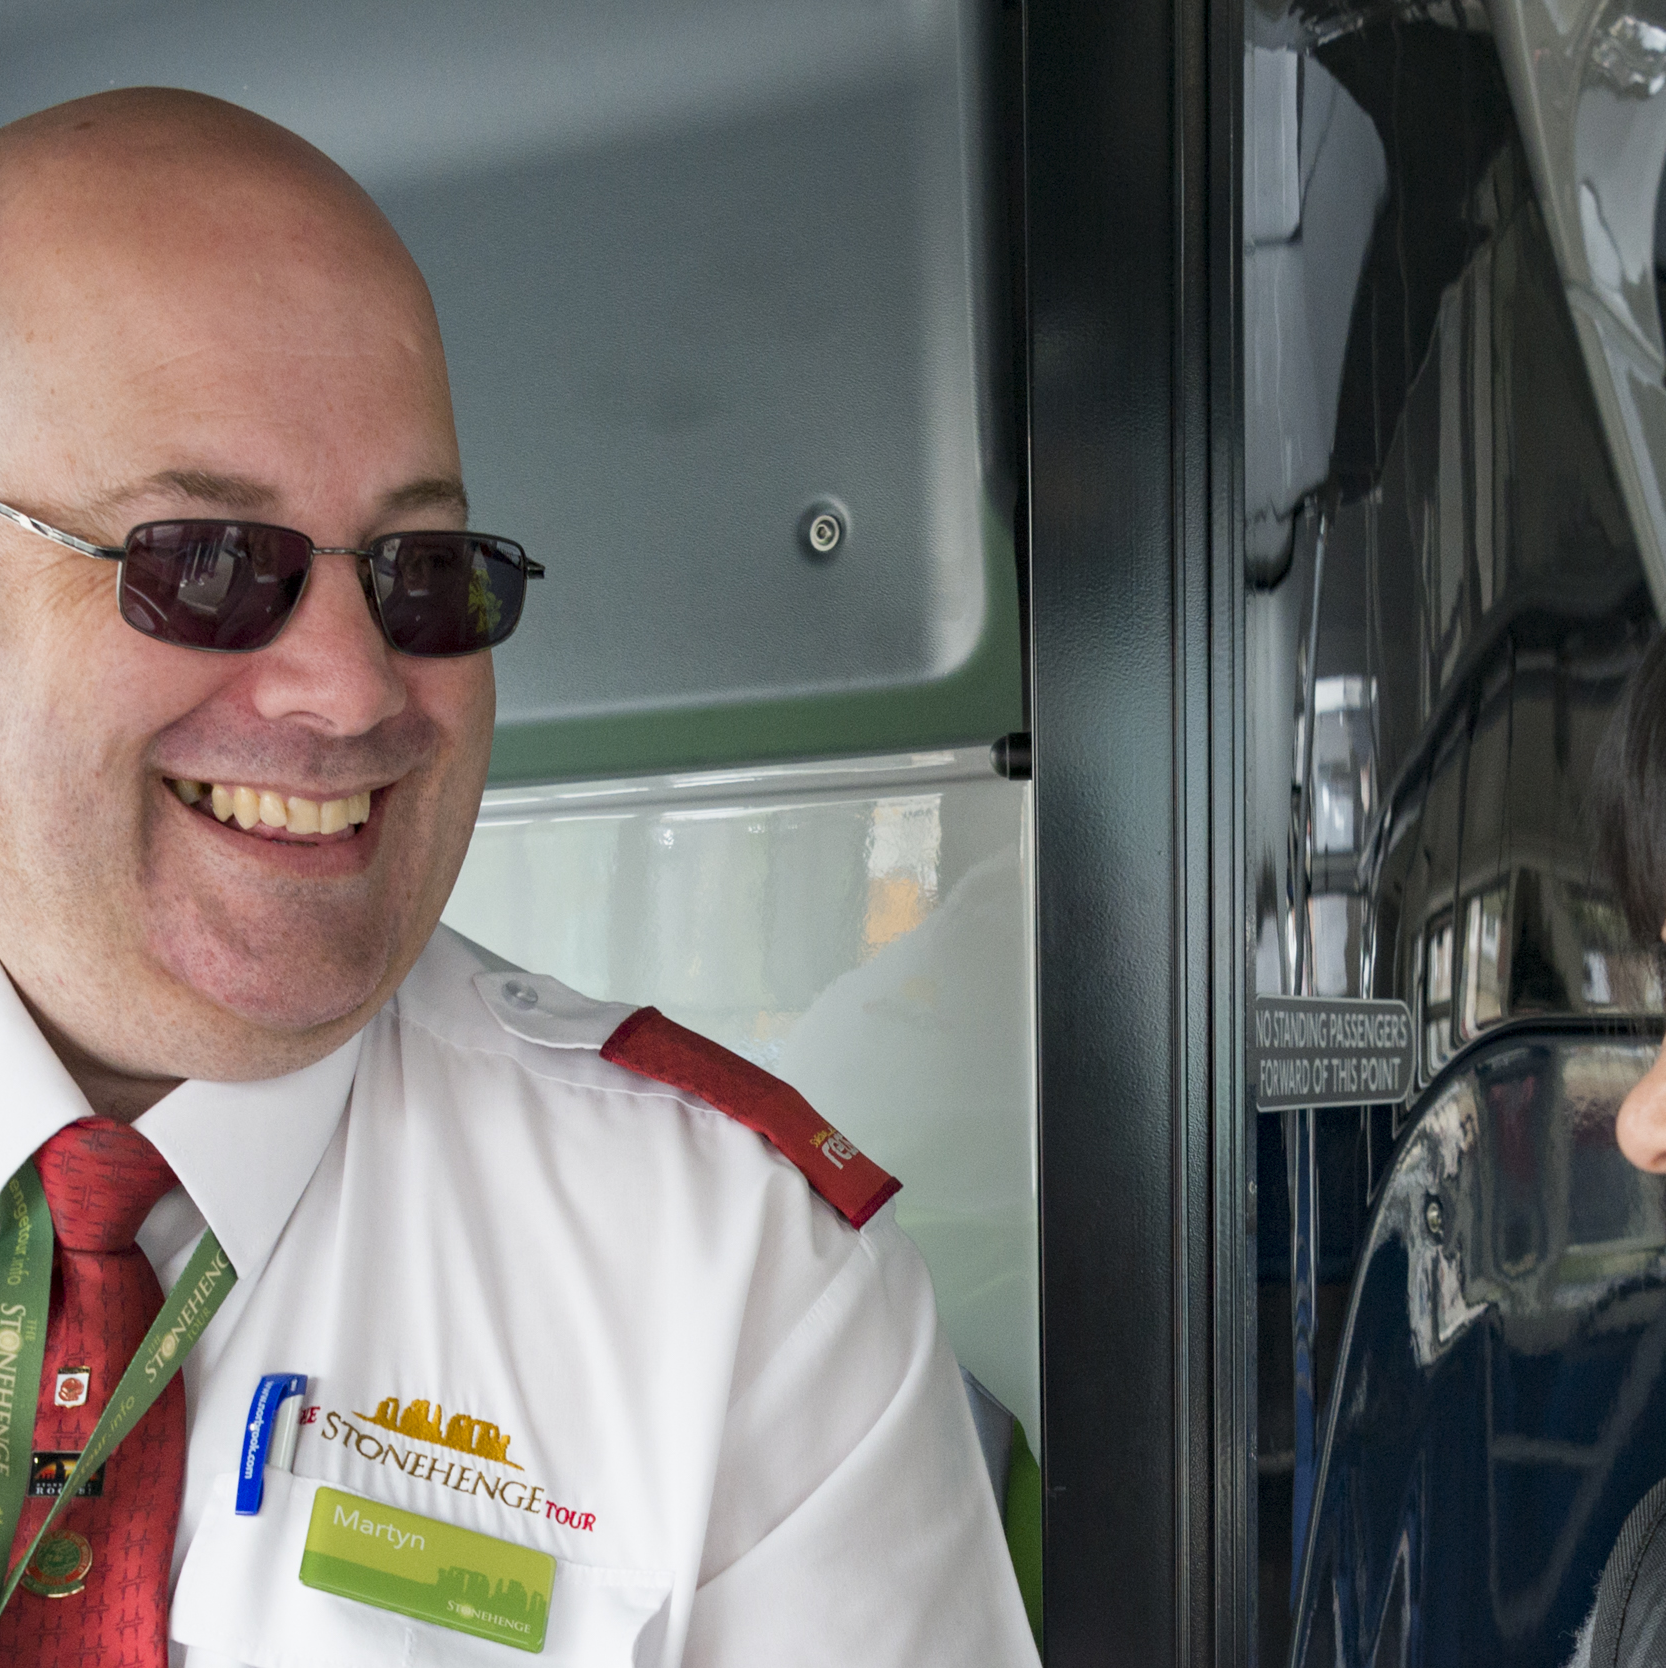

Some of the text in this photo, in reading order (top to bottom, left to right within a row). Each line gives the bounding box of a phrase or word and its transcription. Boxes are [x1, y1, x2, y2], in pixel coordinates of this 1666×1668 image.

[1255, 1009, 1408, 1049] NO STANDING PASSENGERS
[1259, 1057, 1401, 1098] FORWARD OF THIS POINT
[8, 1178, 31, 1286] engetour.info
[25, 1318, 38, 1342] THE
[144, 1247, 232, 1384] STONEHENG
[186, 1307, 211, 1343] TOUR
[298, 1405, 597, 1532] HE STONEHENGE TOUR
[333, 1504, 427, 1551] Martyn
[447, 1599, 532, 1635] STONEHENGE
